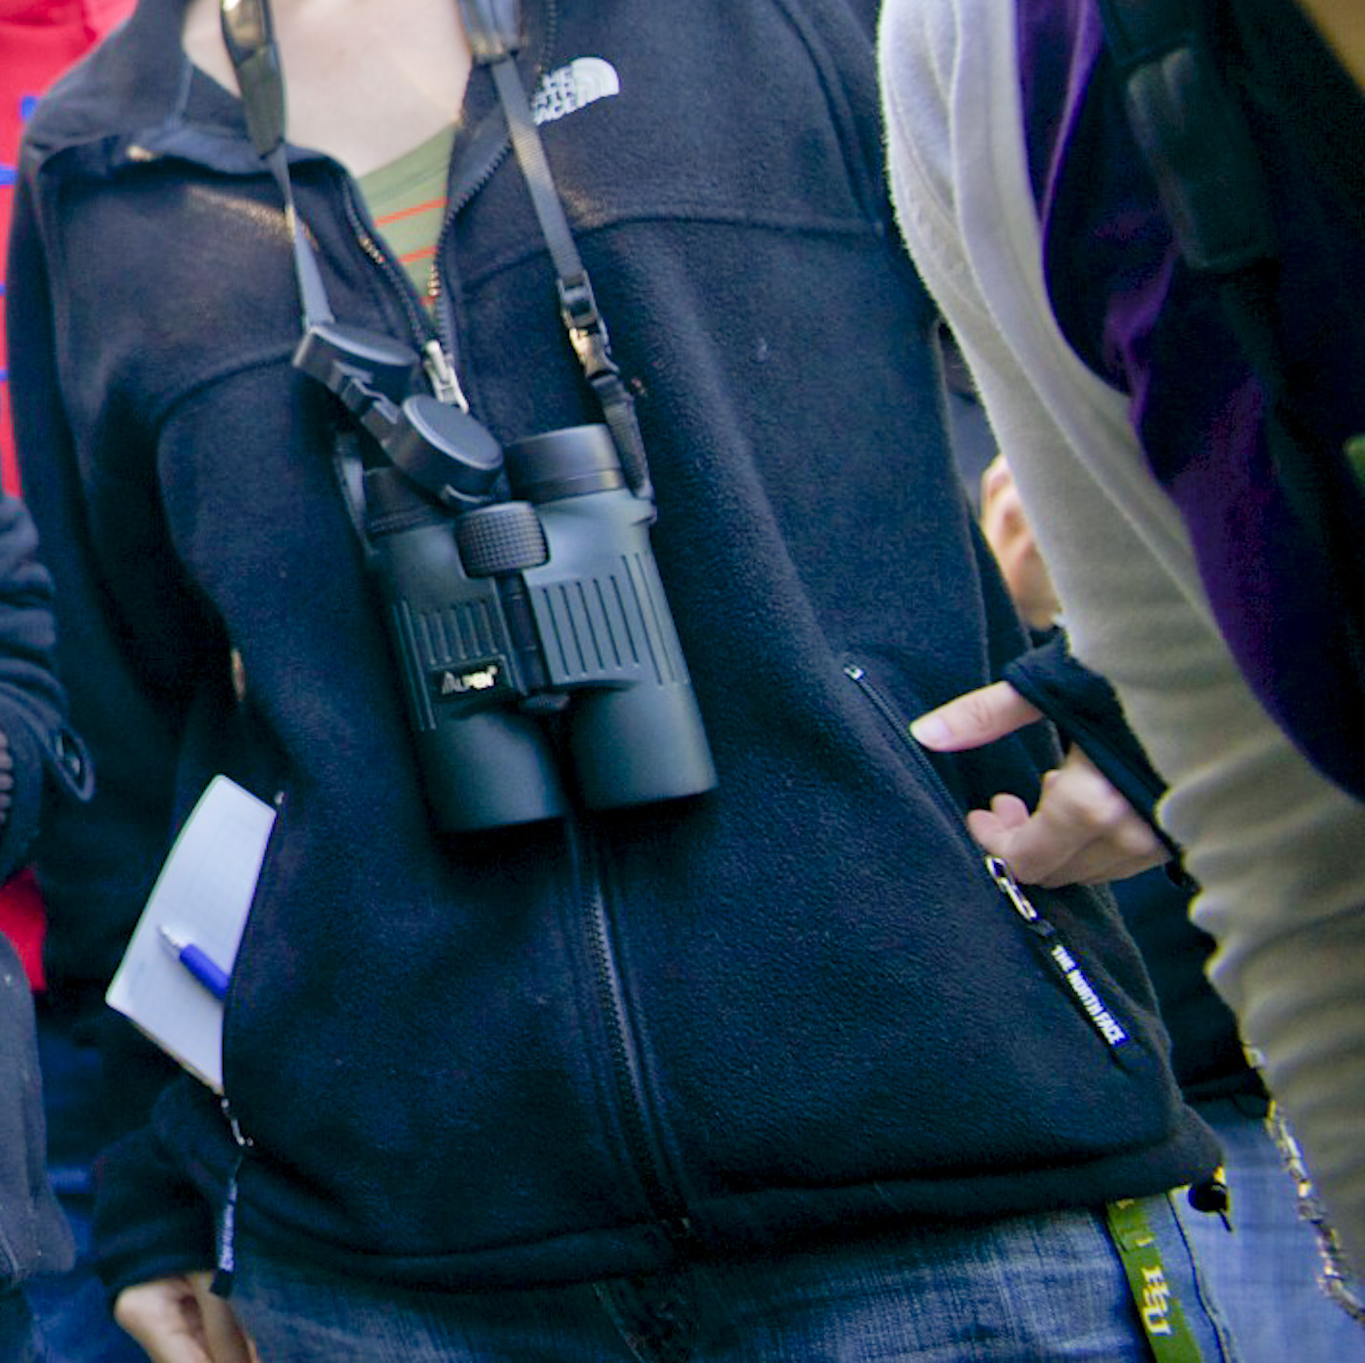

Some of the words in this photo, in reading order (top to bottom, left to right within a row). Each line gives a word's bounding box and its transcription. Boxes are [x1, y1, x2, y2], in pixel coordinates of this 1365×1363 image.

[1051, 944, 1077, 973] THE
[1066, 969, 1104, 1017] NORTH
[1092, 1011, 1127, 1045] FACE
